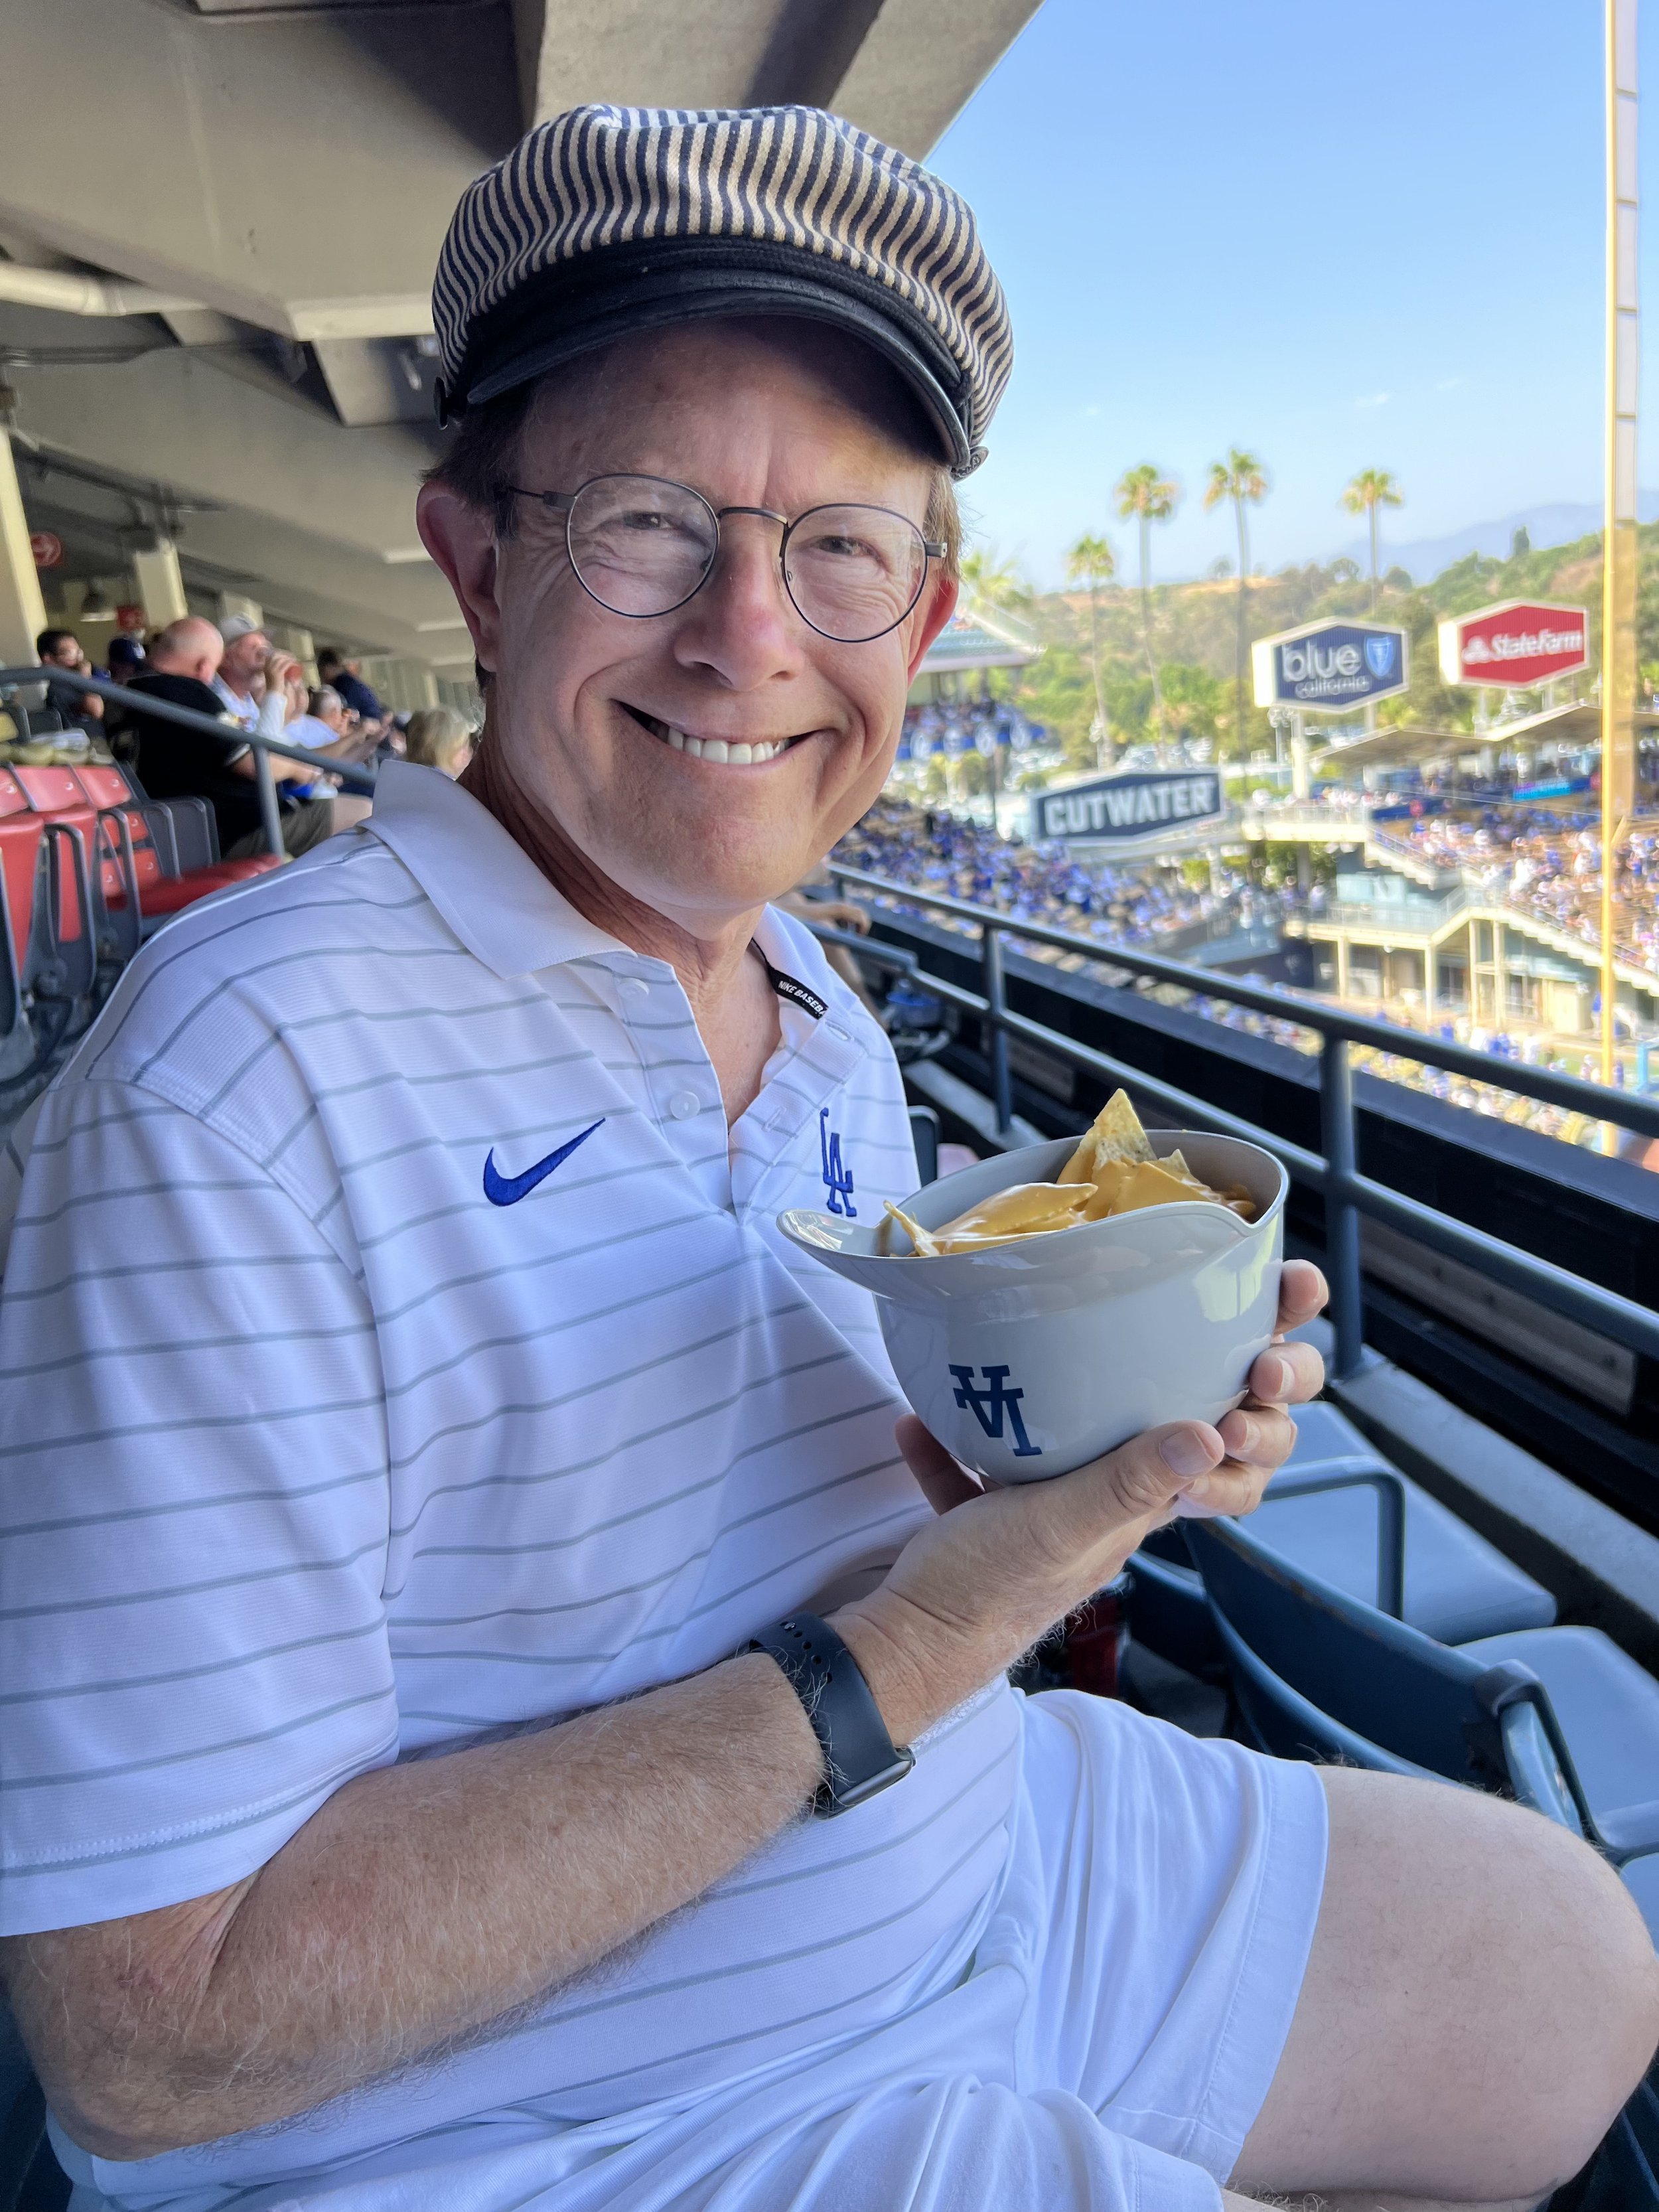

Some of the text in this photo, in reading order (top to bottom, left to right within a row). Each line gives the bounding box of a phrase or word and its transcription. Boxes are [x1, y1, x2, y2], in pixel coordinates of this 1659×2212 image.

[1282, 640, 1361, 682] blue
[1045, 776, 1215, 836] CUTWATER
[778, 980, 796, 994] NIKE
[820, 1107, 857, 1217] LA
[948, 1364, 1043, 1457] LA
